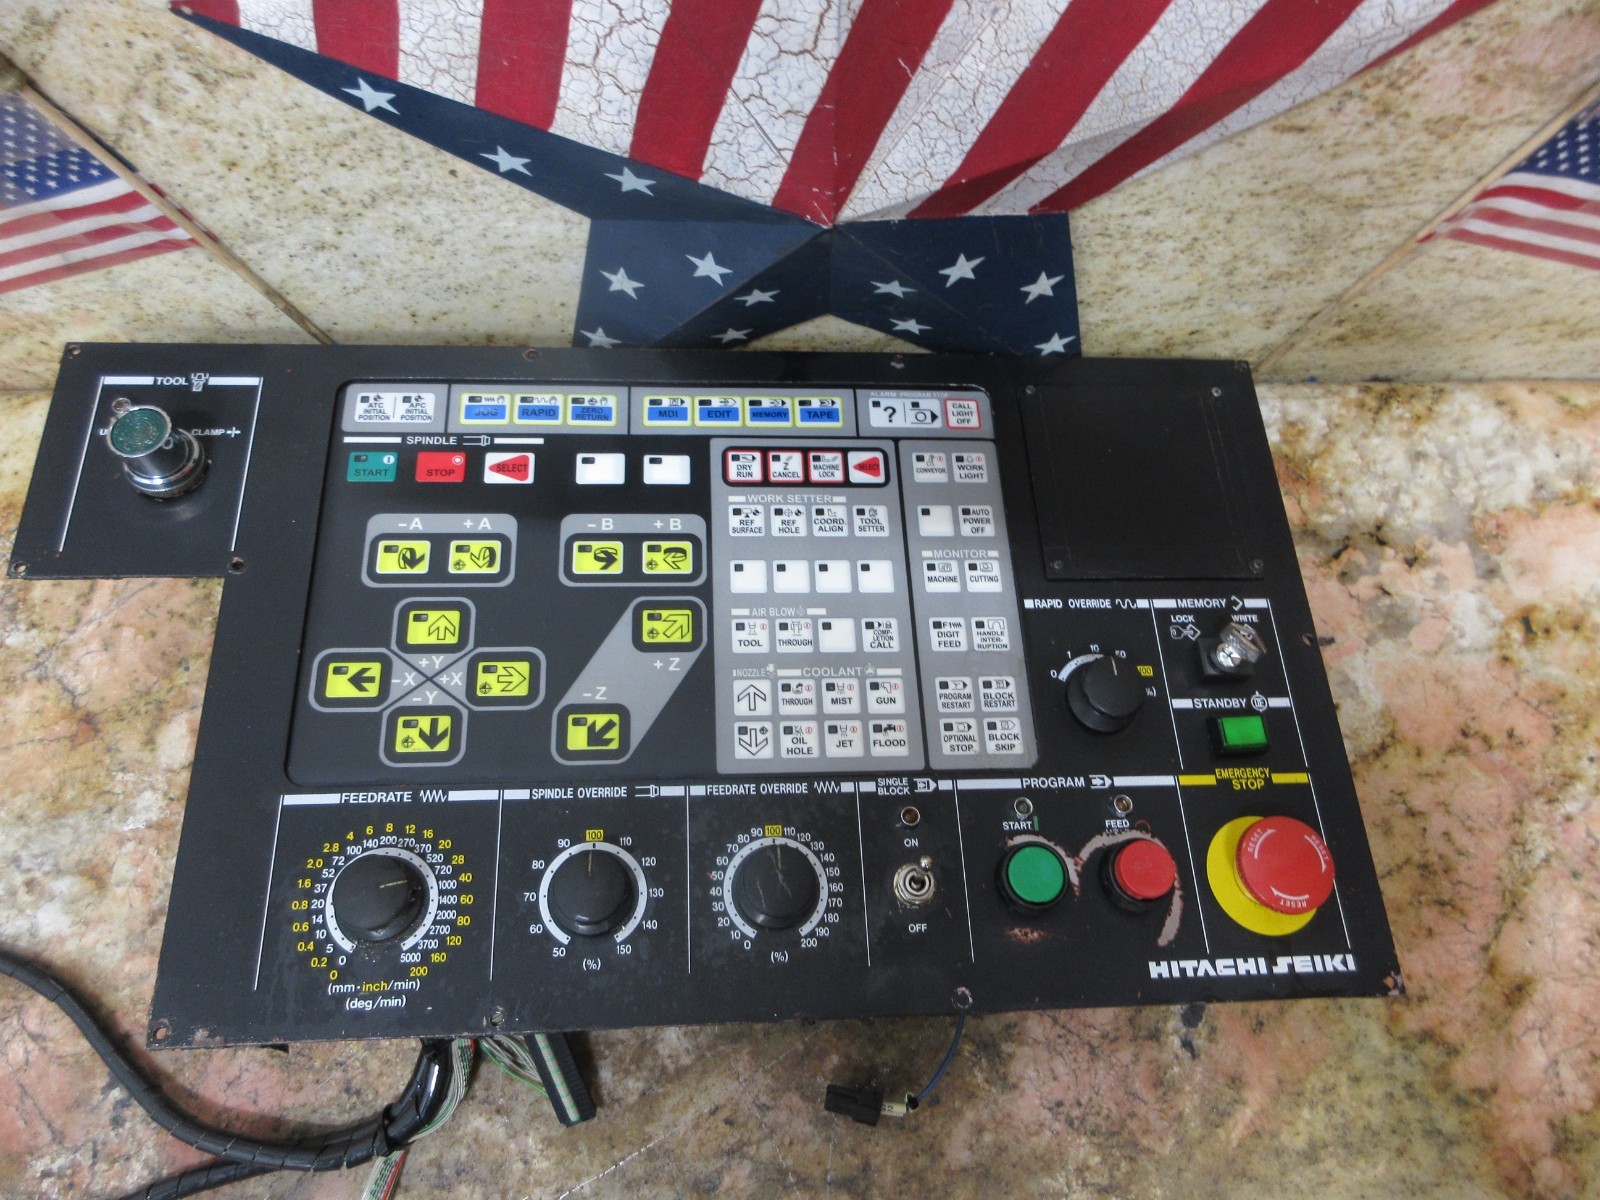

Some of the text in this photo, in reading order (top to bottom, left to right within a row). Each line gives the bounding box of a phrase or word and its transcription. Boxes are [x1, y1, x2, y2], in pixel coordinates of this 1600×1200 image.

[156, 376, 188, 386] TOOL
[474, 408, 499, 416] JOG
[522, 408, 556, 416] RAPID
[659, 410, 679, 418] MDI
[708, 410, 731, 418] EDIT
[807, 411, 834, 419] TAPE
[192, 428, 225, 436] CLAMP
[407, 436, 457, 445] SPINDLE
[496, 464, 528, 472] SELECT
[354, 469, 389, 477] START
[426, 469, 455, 477] STOP
[747, 495, 832, 503] WORK SETTER
[933, 550, 988, 558] MONITOR
[1034, 599, 1112, 608] RAPID OVERRIDE
[1177, 599, 1226, 608] MEMORY
[752, 608, 795, 616] AIR BLOW
[938, 640, 961, 648] FEED
[803, 667, 862, 676] COOLANT
[1050, 670, 1057, 678] 0
[1194, 699, 1246, 708] STANDBY
[1215, 768, 1270, 779] EMERGENCY
[878, 778, 908, 786] SINGLE
[1022, 777, 1084, 788] PROGRAM
[1232, 780, 1264, 790] STOP
[532, 787, 627, 799] SPINDLE OVERRIDE
[707, 783, 808, 795] FEEDRATE OVERRIDE
[878, 787, 910, 795] BLOCK
[341, 792, 412, 803] FEEDRATE
[1002, 822, 1032, 830] START
[1105, 820, 1130, 829] FEED
[366, 826, 374, 835] 6
[405, 825, 416, 834] 12
[767, 827, 780, 835] 100
[588, 831, 602, 840] 100
[738, 834, 749, 842] 80
[363, 839, 378, 848] 140
[398, 838, 415, 847] 270
[438, 840, 452, 849] 20
[620, 837, 632, 846] 110
[904, 838, 918, 847] ON
[323, 843, 339, 852] 2.8
[727, 844, 739, 852] 70
[332, 856, 345, 865] 72
[452, 855, 465, 864] 28
[642, 857, 656, 866] 120
[717, 857, 728, 865] 60
[435, 866, 452, 874] 720
[459, 873, 472, 882] 40
[712, 871, 723, 880] 50
[314, 884, 327, 893] 37
[649, 888, 664, 897] 130
[710, 887, 722, 896] 40
[311, 899, 325, 908] 20
[460, 895, 473, 904] 60
[712, 902, 724, 911] 30
[436, 911, 456, 920] 2000
[293, 922, 310, 931] 0.6
[642, 920, 658, 929] 140
[718, 918, 730, 926] 20
[430, 925, 450, 934] 2700
[909, 924, 927, 932] OFF
[731, 930, 740, 939] 10
[446, 936, 462, 945] 120
[744, 941, 751, 949] 0
[326, 944, 334, 953] 5
[617, 945, 632, 954] 150
[339, 956, 346, 965] 0
[431, 953, 447, 962] 160
[771, 951, 788, 962] (%)
[582, 958, 601, 970] (%)
[1149, 954, 1356, 979] HITACHI SEIKI
[410, 967, 428, 976] 200
[345, 995, 407, 1010] (deg/min)
